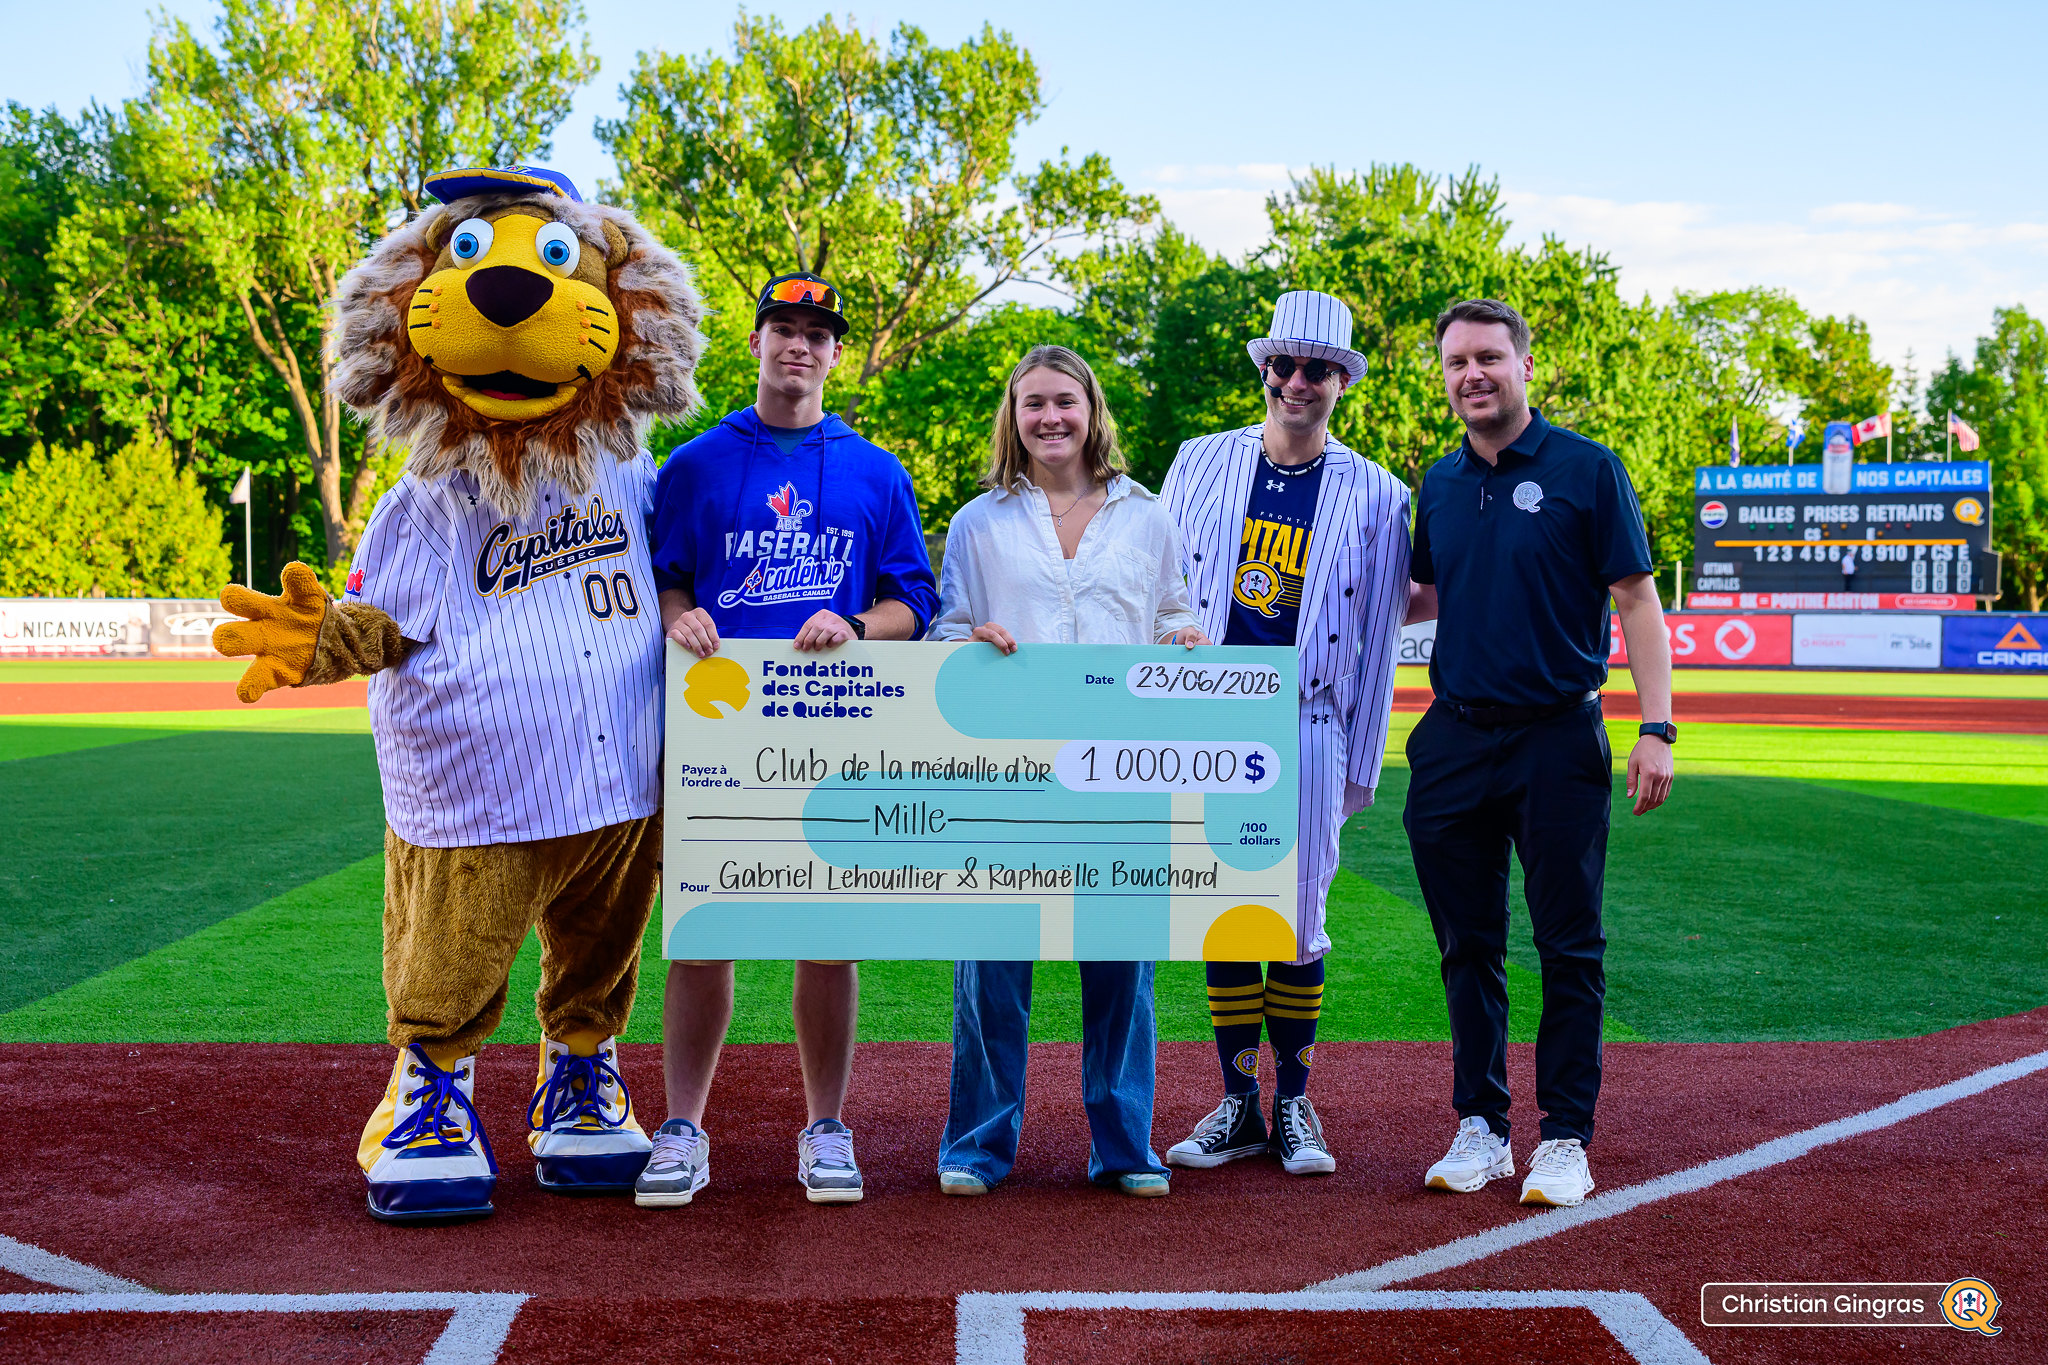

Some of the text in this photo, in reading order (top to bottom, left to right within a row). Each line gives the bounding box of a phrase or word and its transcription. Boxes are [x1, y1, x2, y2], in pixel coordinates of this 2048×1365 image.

[1699, 470, 1982, 490] À LA SANTÉ DE NOS CAPITALES
[1738, 504, 1944, 523] BALLES PRISES RETRAITS
[776, 517, 802, 531] ABC
[1804, 528, 1821, 541] CS
[1866, 527, 1875, 541] E
[474, 494, 630, 599] Capitales
[1754, 545, 1763, 562] 1
[1767, 545, 1779, 562] 2
[1781, 545, 1793, 562] 3
[1800, 545, 1811, 562] 4
[1814, 545, 1826, 562] 5
[1828, 545, 1840, 562] 6
[1861, 544, 1873, 562] 8
[1914, 544, 1926, 561] P
[1931, 544, 1953, 561] CS
[1958, 544, 1969, 561] E
[534, 549, 596, 574] QUÉBEC
[718, 554, 845, 609] Académie
[582, 570, 640, 621] 00
[763, 589, 831, 602] BASEBALL CANADA
[3, 612, 118, 638] NICANVAS
[763, 660, 874, 678] Fondation
[1085, 674, 1115, 685] Date
[1136, 665, 1281, 695] 23/06/2026
[762, 680, 905, 701] des Capitales
[762, 701, 873, 719] de Québec
[682, 764, 727, 777] Payez à
[756, 746, 828, 782] Club
[841, 753, 870, 781] de
[881, 749, 903, 780] la
[911, 755, 998, 783] médaille
[1081, 746, 1266, 785] 1 000,00 $
[681, 777, 741, 788] l'ordre de
[874, 800, 947, 836] Mille
[1239, 822, 1267, 833] /100
[1239, 835, 1281, 846] dollars
[719, 856, 1218, 891] Gabriel Lehouillier & Raphaëlle Bouchard
[680, 882, 710, 892] Pour
